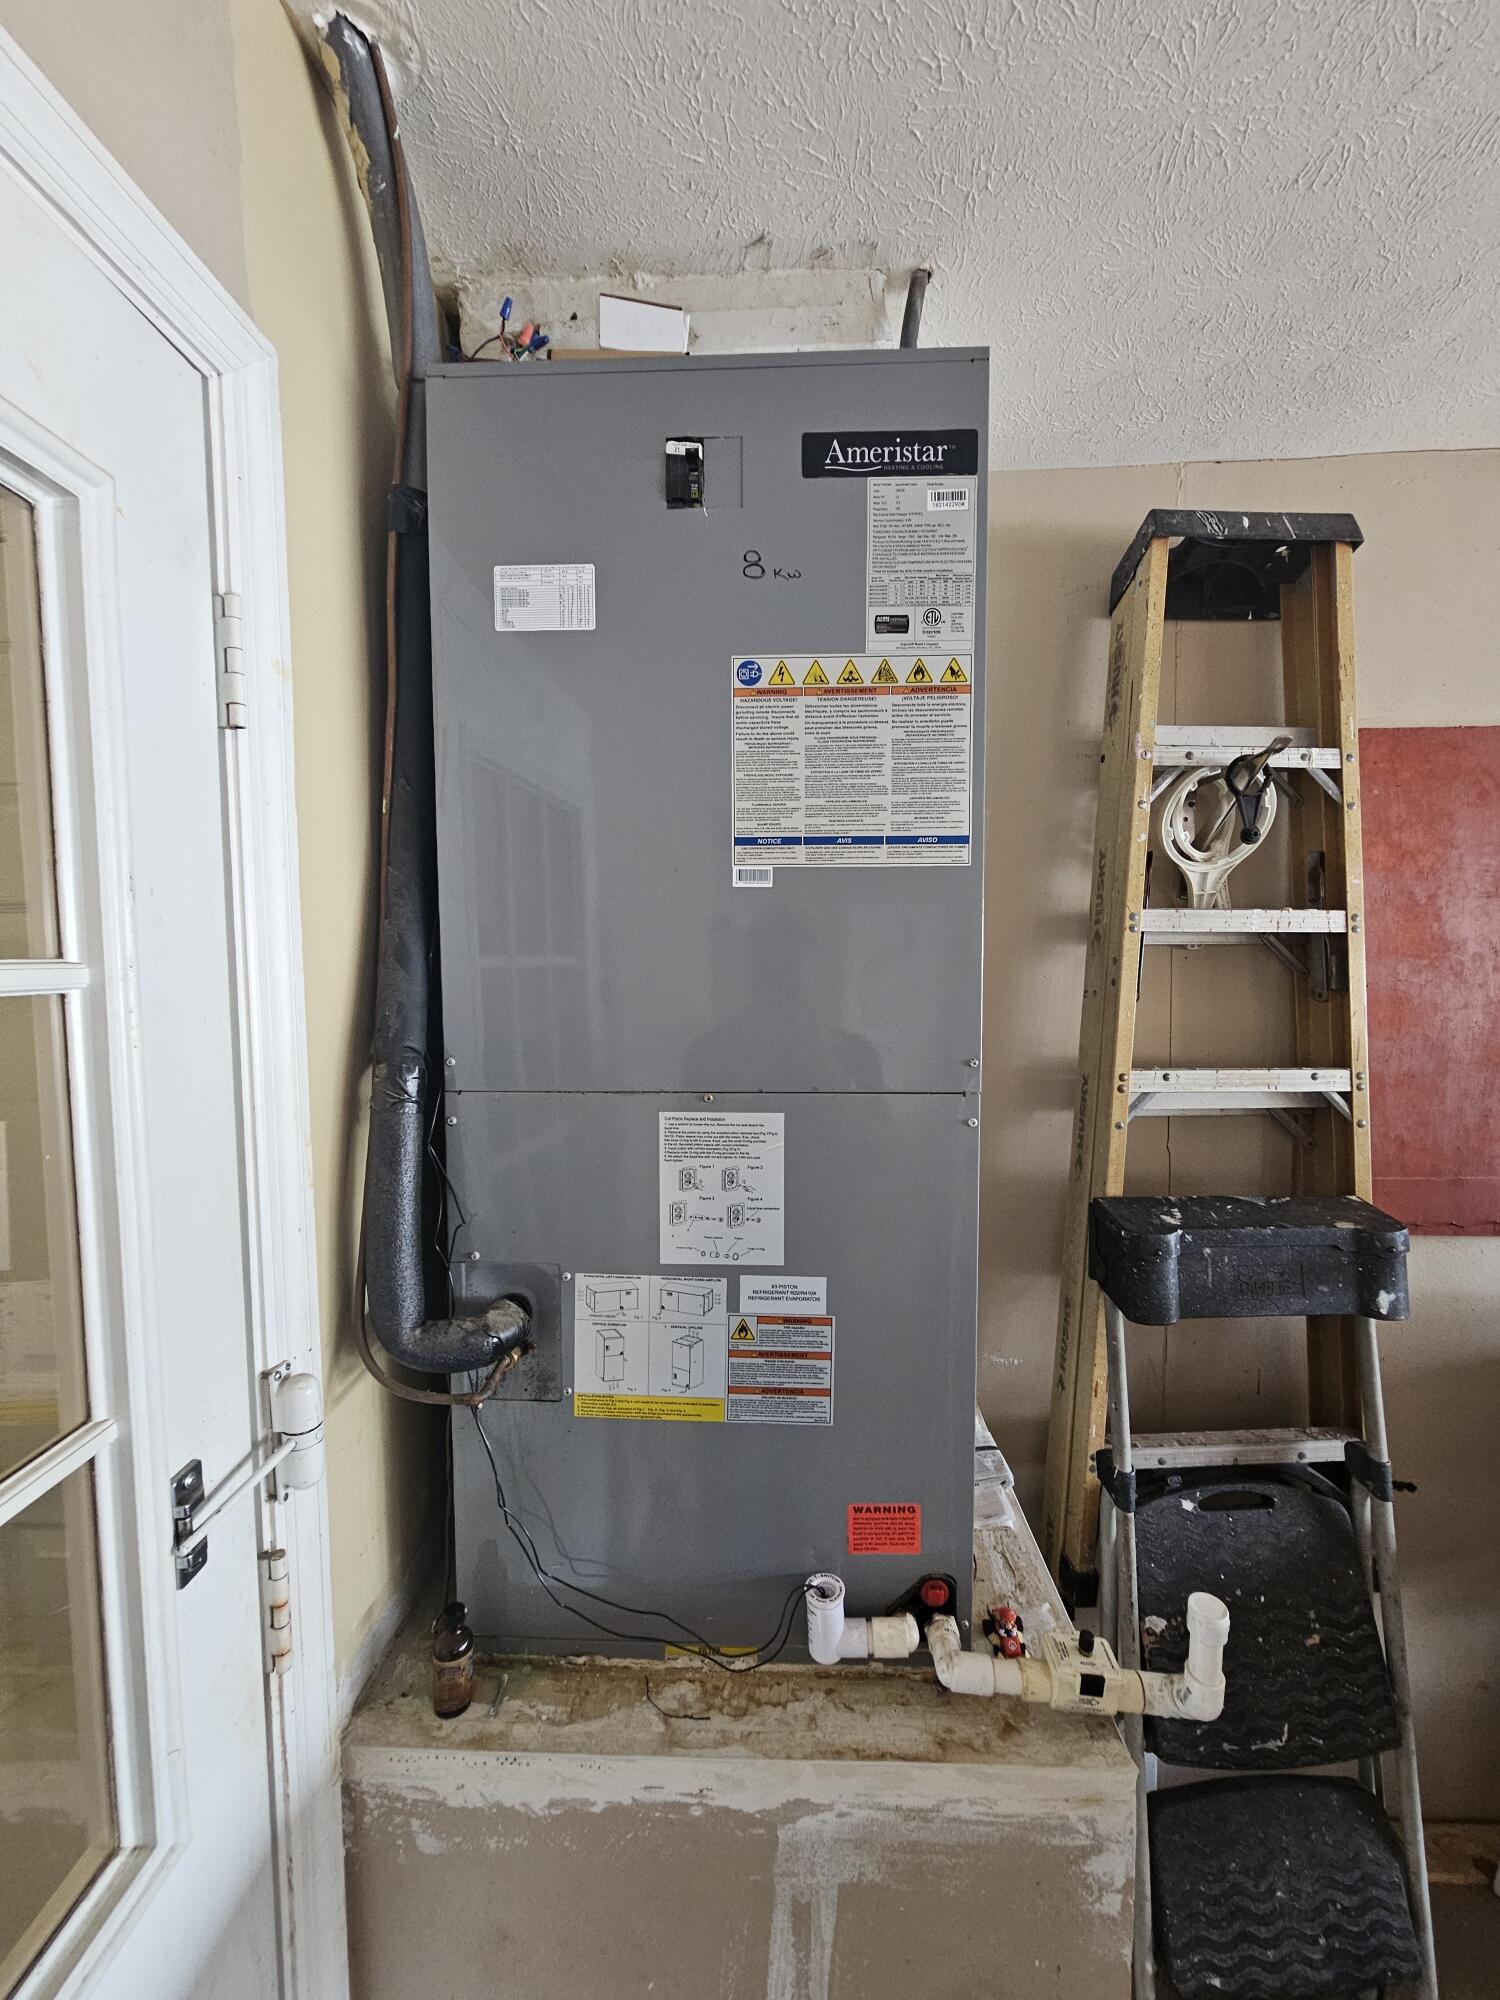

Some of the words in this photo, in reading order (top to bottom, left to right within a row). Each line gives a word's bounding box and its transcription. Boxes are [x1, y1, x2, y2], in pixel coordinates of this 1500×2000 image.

[825, 438, 947, 463] Ameristar
[743, 550, 765, 579] 8
[853, 1506, 916, 1514] WARNING
